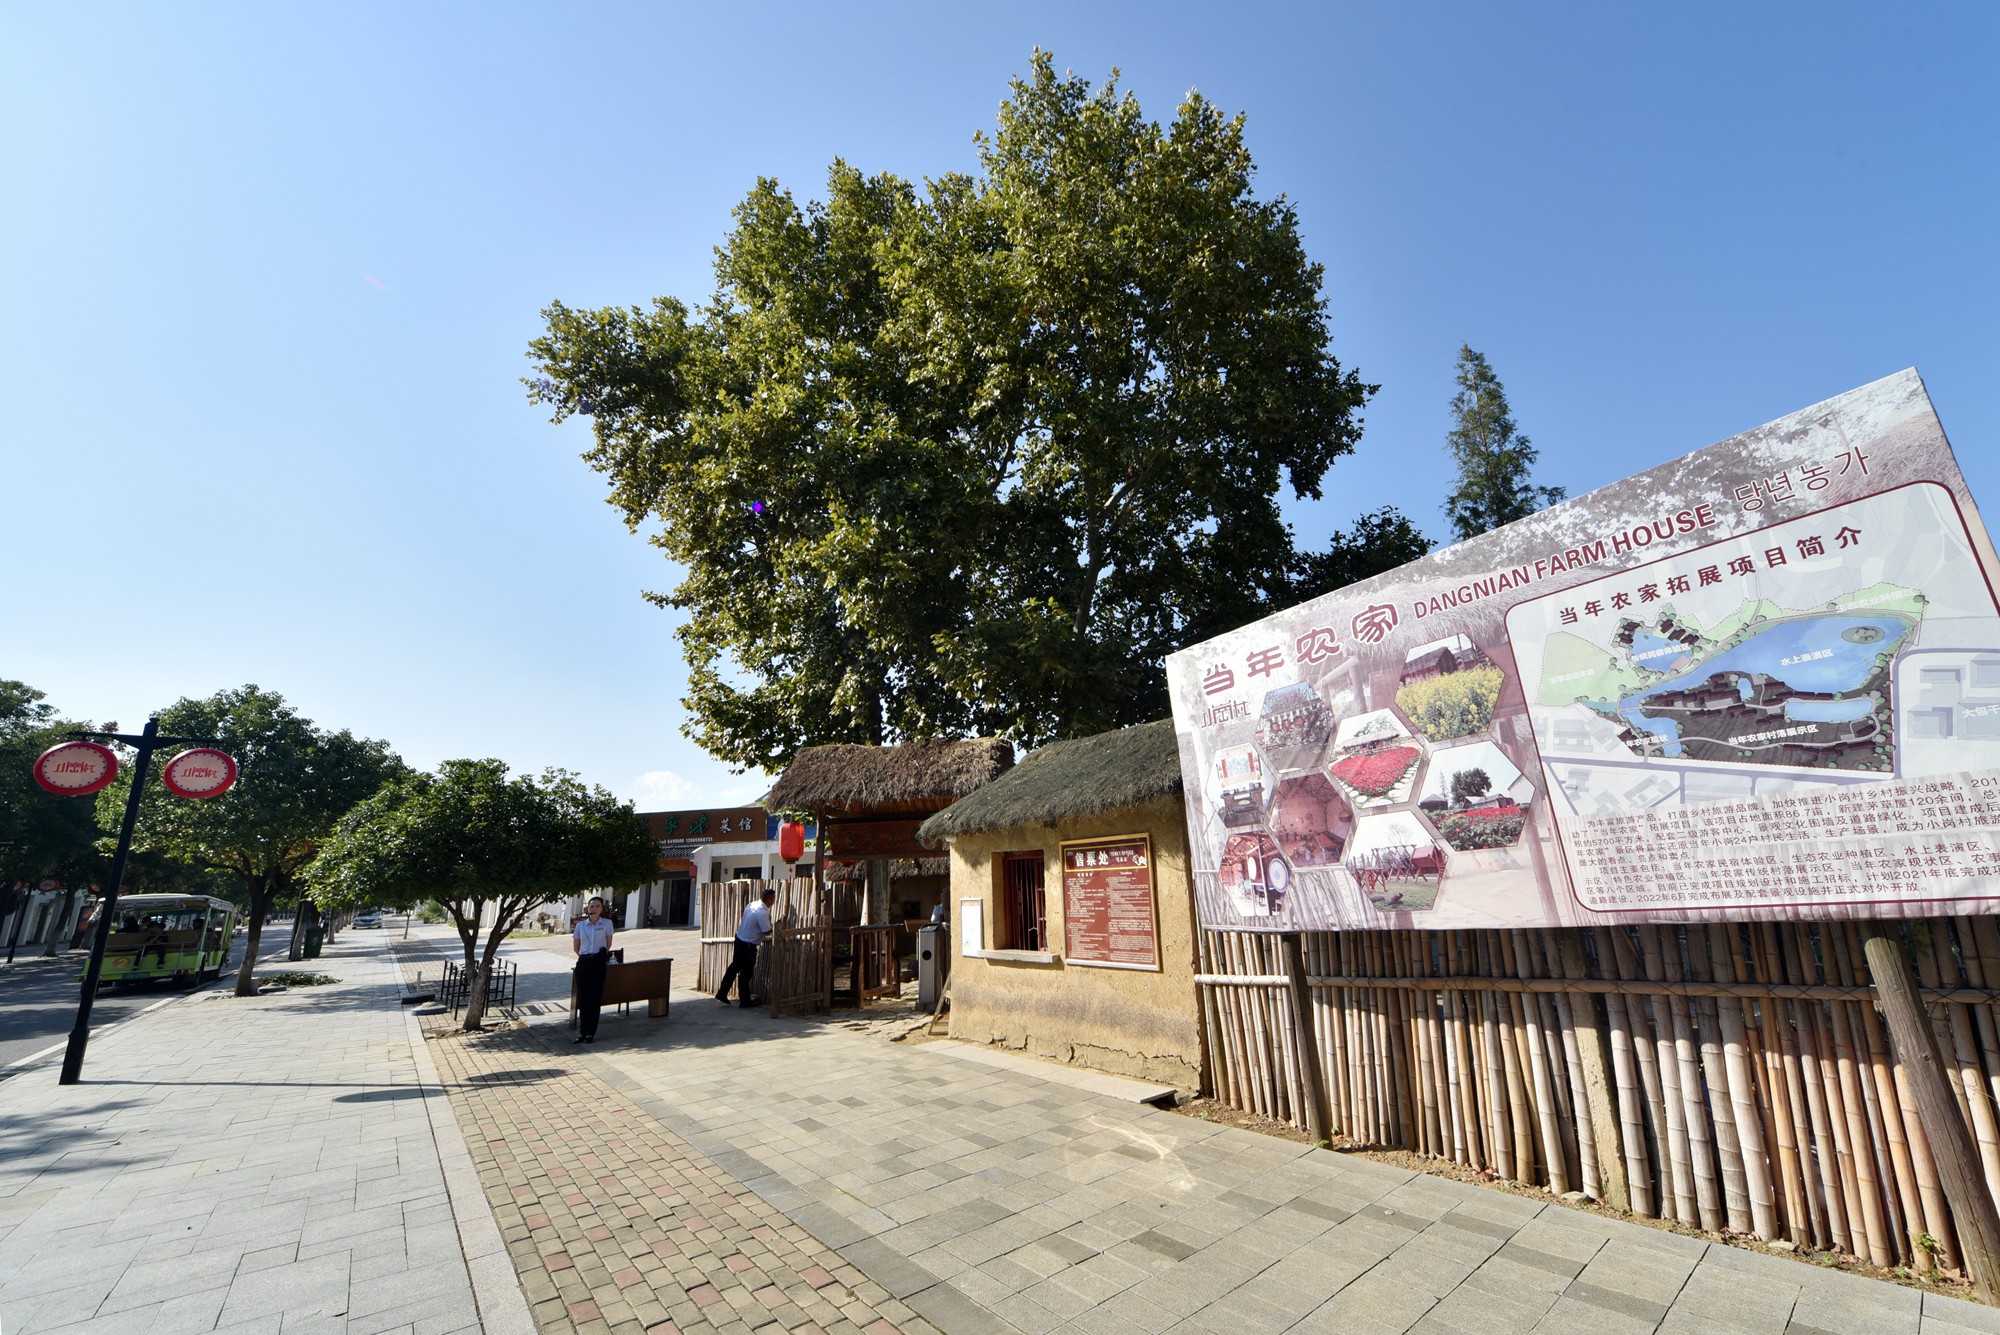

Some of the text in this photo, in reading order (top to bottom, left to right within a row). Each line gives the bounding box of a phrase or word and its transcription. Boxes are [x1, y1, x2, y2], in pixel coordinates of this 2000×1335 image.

[1734, 446, 1871, 513] 당년농가
[1414, 503, 1716, 618] DANGNIAN FARM HOUSE
[1559, 526, 1862, 625] 当年农家拓展项目简介
[1203, 603, 1399, 696] 当年农家
[1780, 648, 1834, 666] 水上表演区
[1621, 734, 1667, 748] 年农家现状
[1728, 724, 1819, 745] 当年农家村落展示区
[1075, 850, 1109, 867] 售票处
